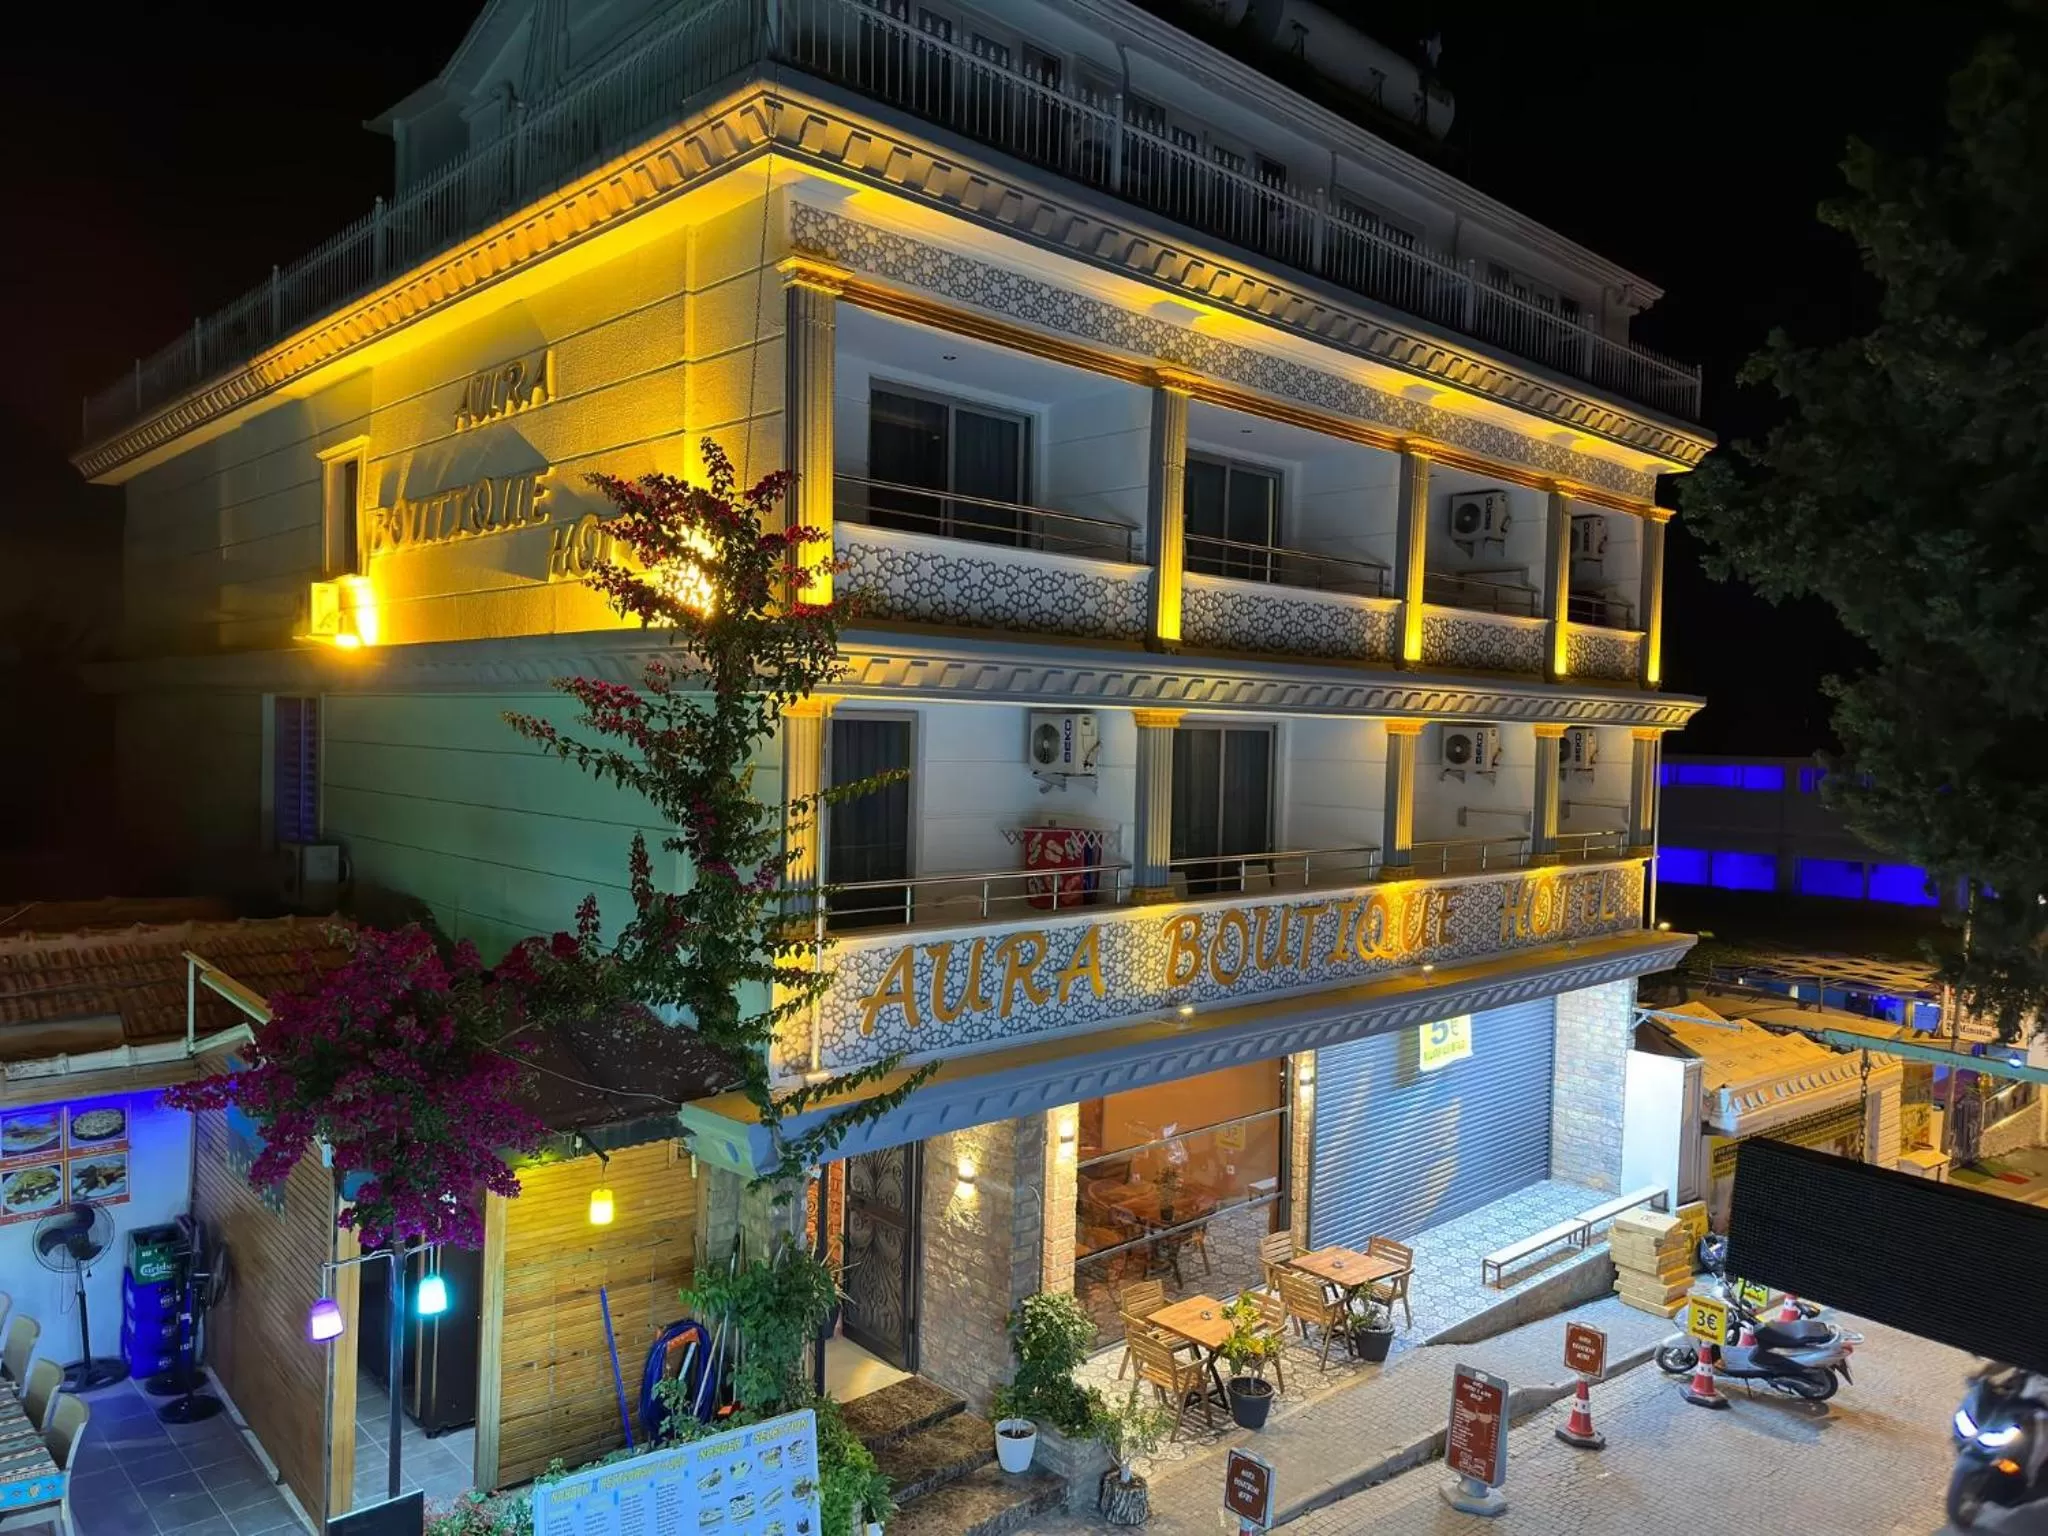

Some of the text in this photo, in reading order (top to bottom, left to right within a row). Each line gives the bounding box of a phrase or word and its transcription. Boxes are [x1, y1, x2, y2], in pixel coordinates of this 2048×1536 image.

[453, 349, 557, 432] AURA
[372, 465, 556, 553] BOUTIQUE
[1064, 718, 1072, 763] BEKO
[857, 869, 1617, 1036] AURA BOUTIQUE HOTEL
[1696, 1310, 1718, 1331] 3€
